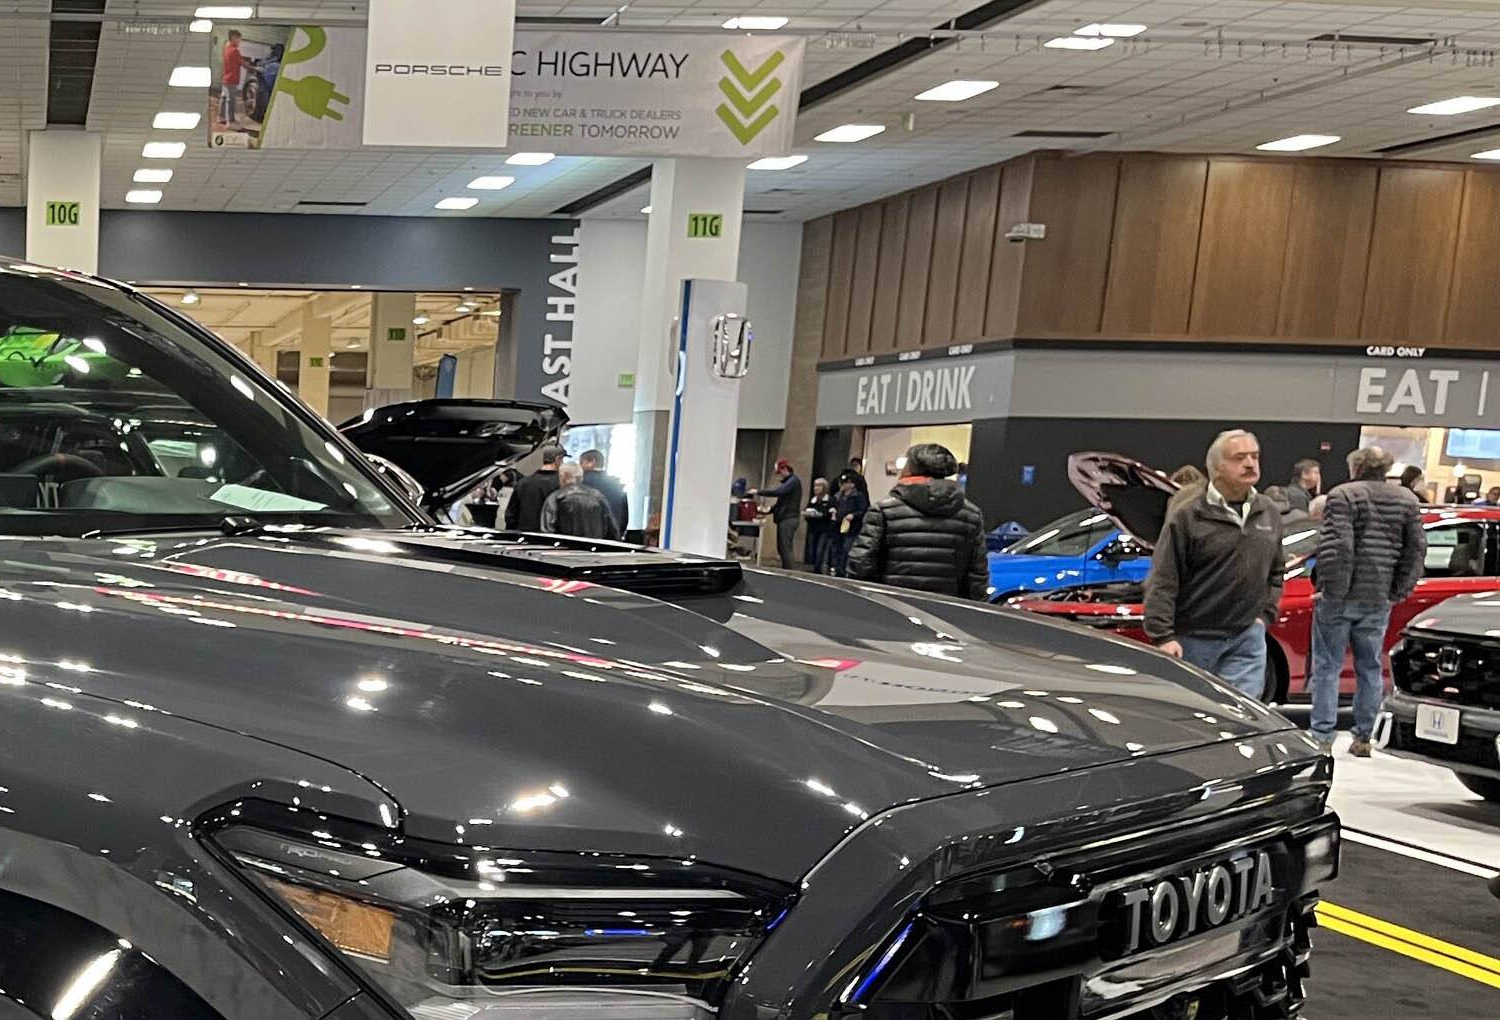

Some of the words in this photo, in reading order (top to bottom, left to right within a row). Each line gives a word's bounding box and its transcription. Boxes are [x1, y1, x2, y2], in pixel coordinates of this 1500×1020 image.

[375, 64, 502, 76] PORSCHE
[537, 51, 689, 78] HIGHWAY
[523, 108, 549, 118] NEW
[552, 108, 577, 118] CAR
[579, 109, 587, 118] &
[590, 109, 627, 119] TRUCK
[630, 110, 681, 120] DEALERS
[580, 124, 680, 139] TOMORROW
[50, 204, 78, 225] 10G
[692, 215, 719, 237] 11G
[546, 227, 581, 321] HALL
[1366, 345, 1394, 357] CARD
[1396, 346, 1426, 358] ONLY
[856, 374, 891, 416] EAT
[905, 365, 976, 412] DRINK
[1356, 367, 1460, 415] EAT
[1123, 852, 1273, 953] TOYOTA
